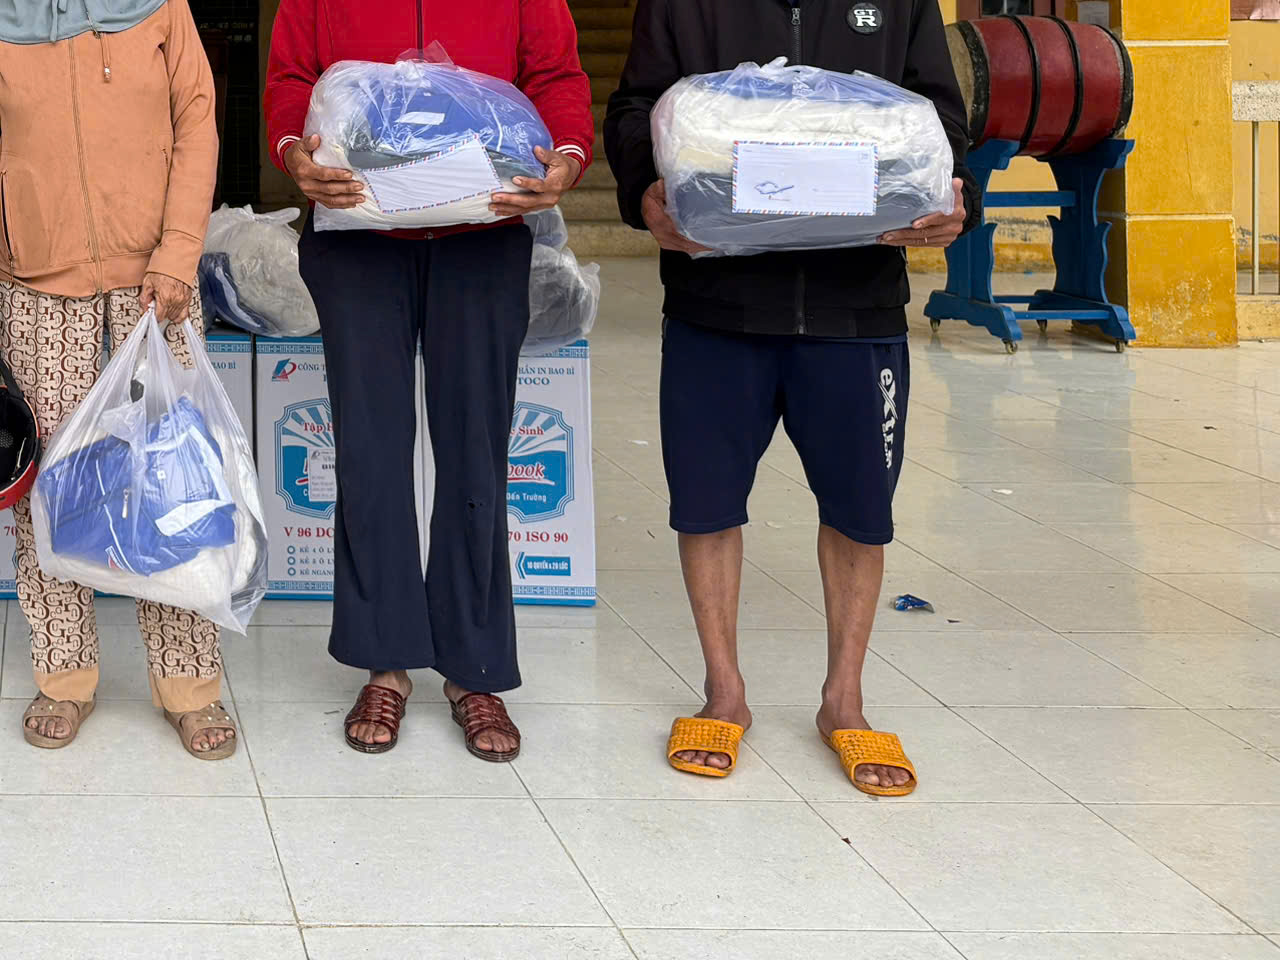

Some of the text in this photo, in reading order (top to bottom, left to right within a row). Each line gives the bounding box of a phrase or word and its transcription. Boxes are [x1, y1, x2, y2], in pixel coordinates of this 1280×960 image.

[298, 361, 319, 371] CÔNG
[538, 367, 546, 375] IN
[548, 367, 564, 376] BAO
[518, 376, 550, 386] TOCO
[304, 422, 324, 433] Tập
[518, 425, 544, 436] Sinh
[284, 526, 293, 536] V
[297, 527, 312, 538] 96
[526, 531, 550, 542] ISO
[554, 532, 568, 543] 90
